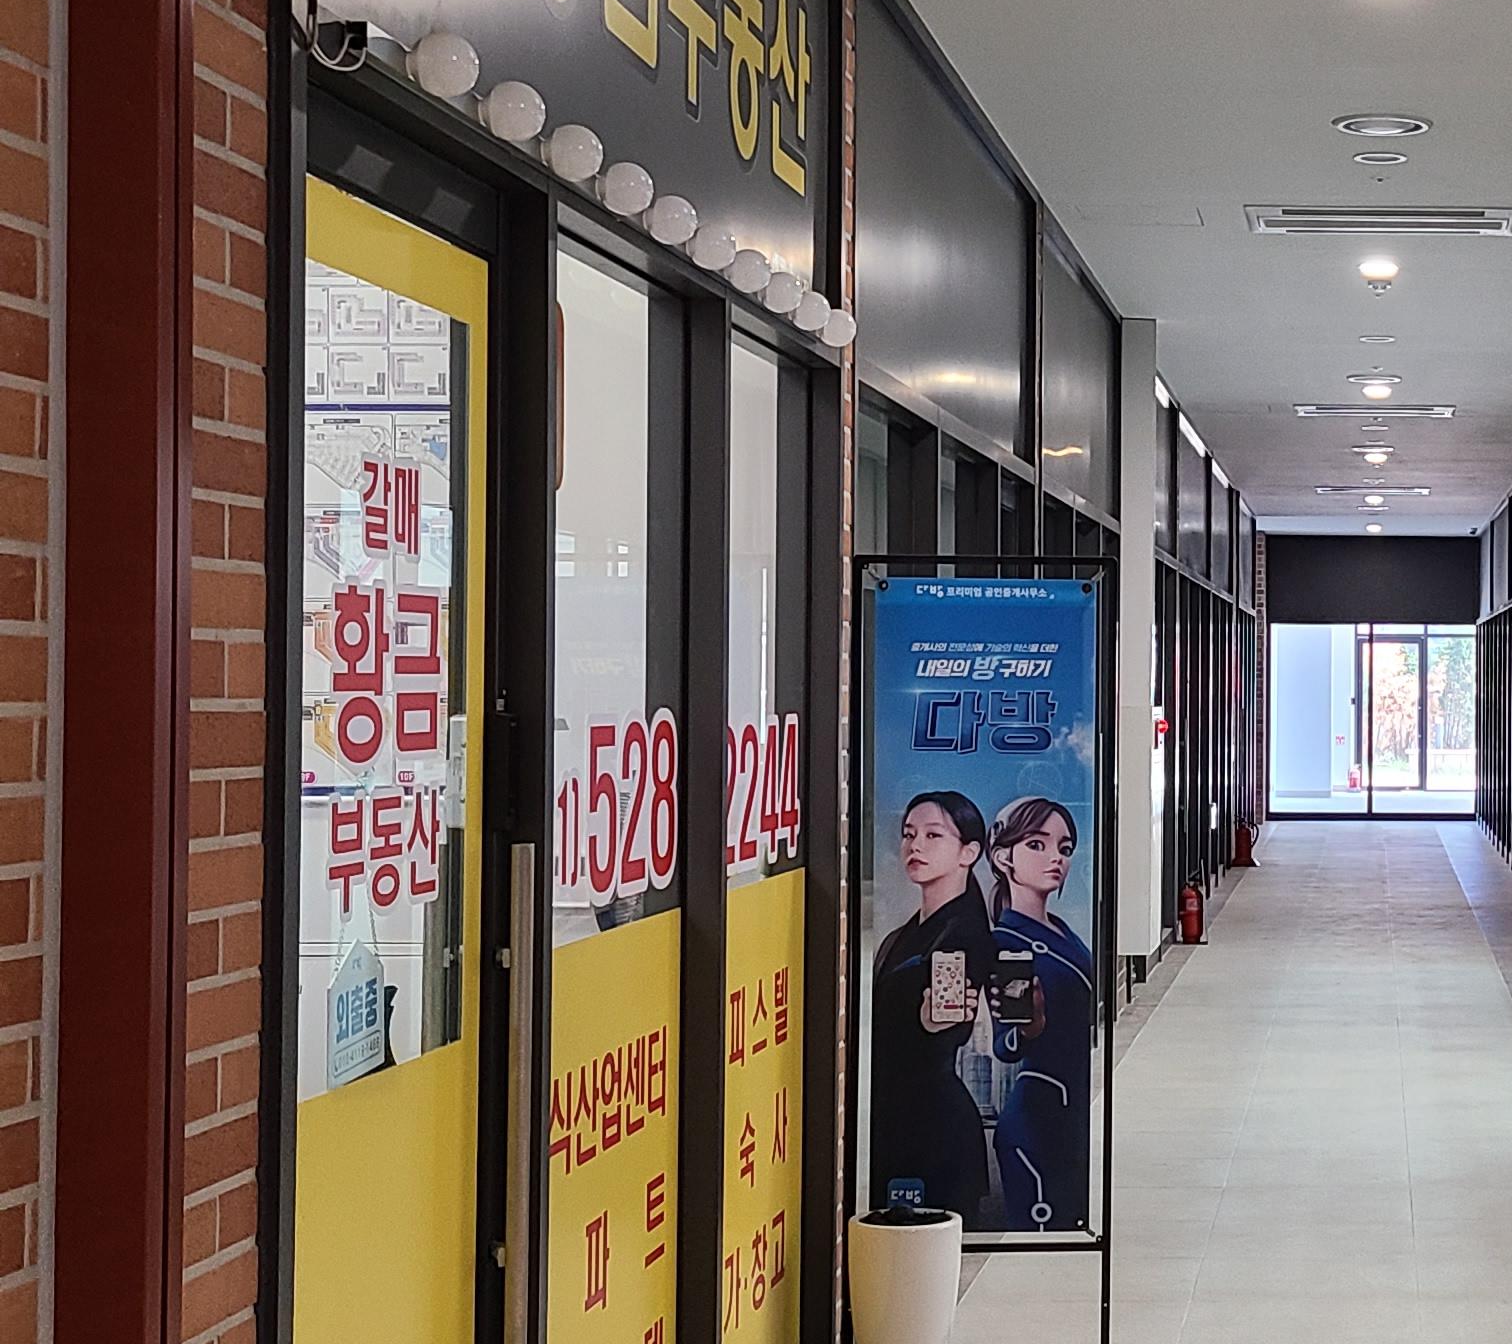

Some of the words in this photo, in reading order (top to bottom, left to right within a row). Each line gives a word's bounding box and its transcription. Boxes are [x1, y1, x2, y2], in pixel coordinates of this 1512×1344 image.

[363, 462, 418, 555] 갈매
[946, 587, 982, 598] 프리미엄
[333, 585, 440, 764] 황금
[916, 659, 971, 677] 내일의
[972, 656, 1000, 680] 방
[1000, 659, 1052, 678] 구하기
[911, 690, 1058, 754] 다방
[329, 790, 439, 914] 부동산
[336, 977, 377, 1044] 외출중
[549, 1025, 667, 1176] 식산업센터
